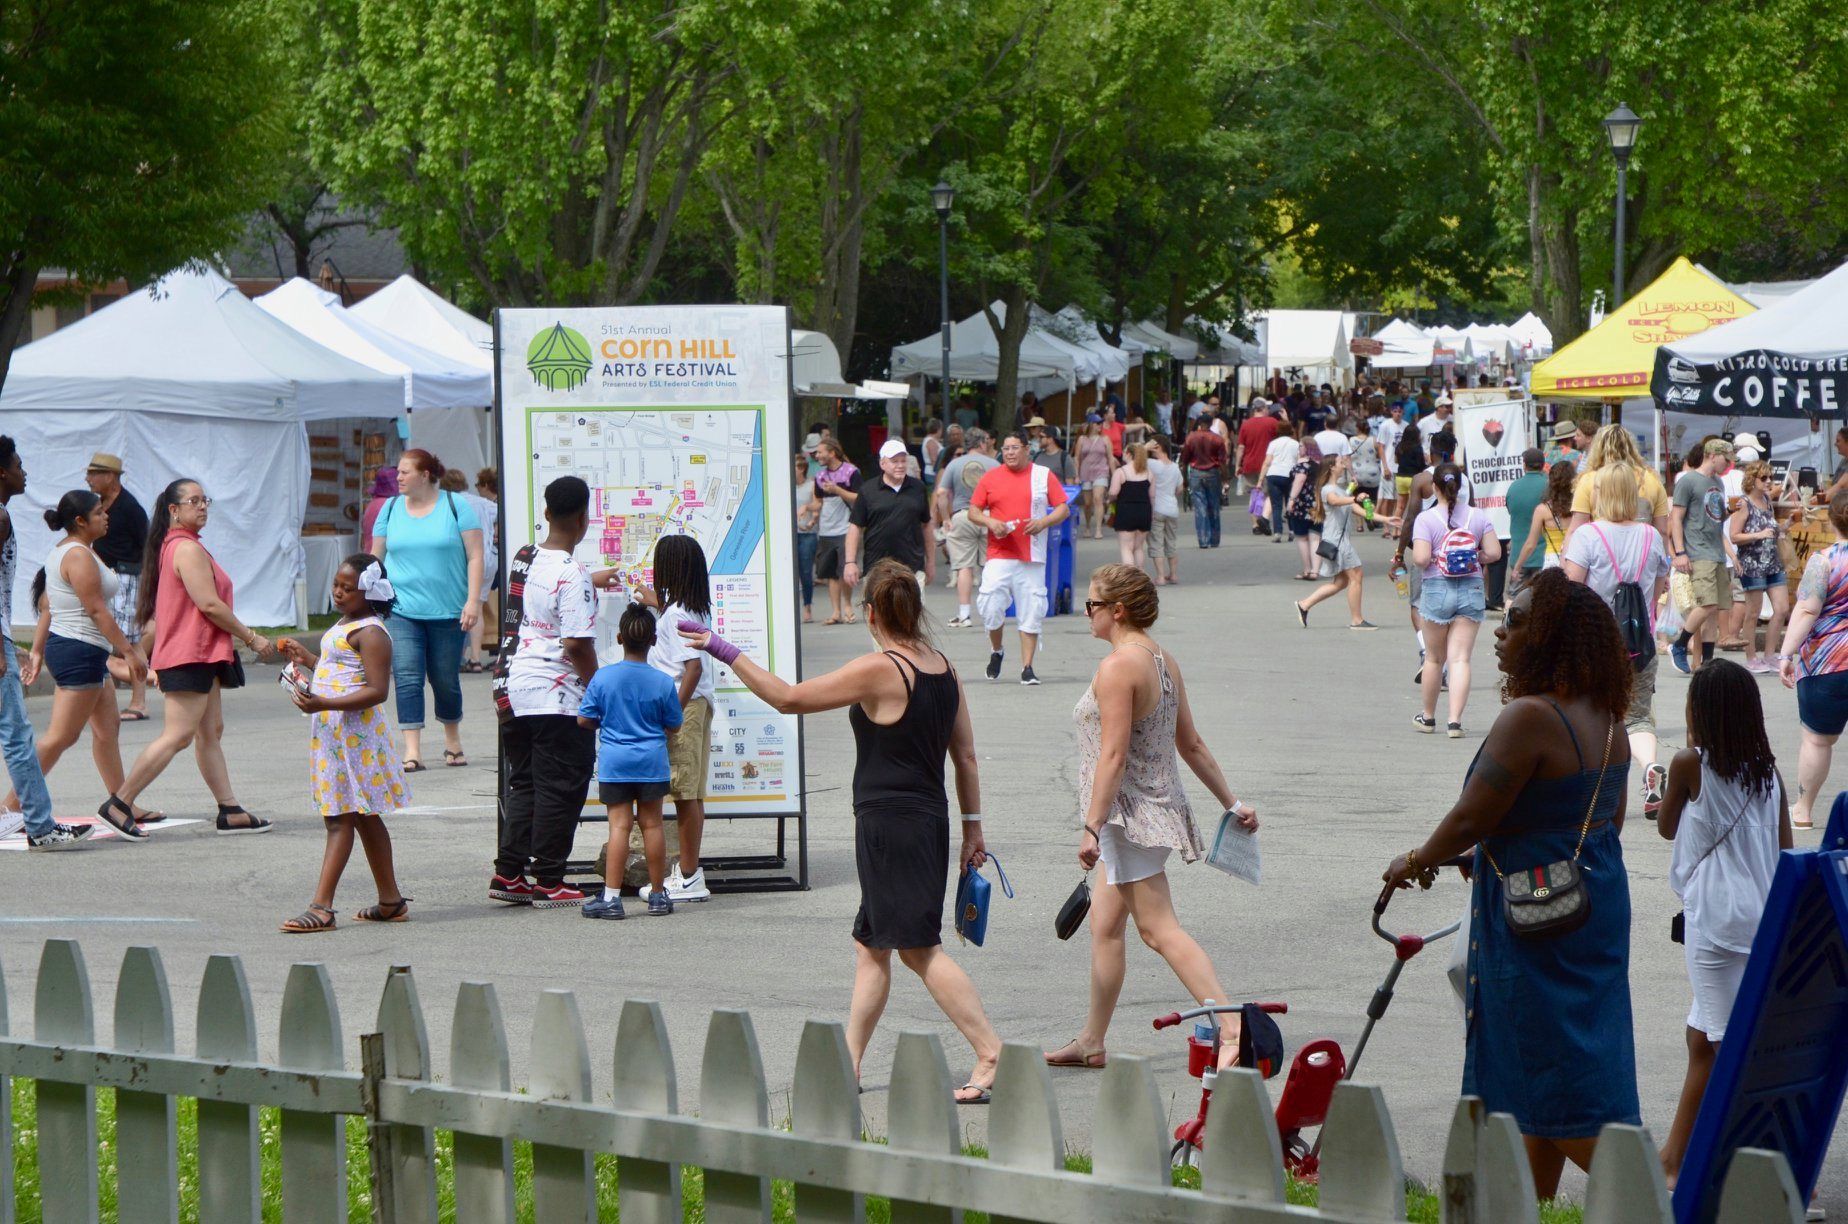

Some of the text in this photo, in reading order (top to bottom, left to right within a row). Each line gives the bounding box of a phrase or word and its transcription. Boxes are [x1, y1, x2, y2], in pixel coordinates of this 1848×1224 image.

[1639, 301, 1735, 316] LEMON
[601, 324, 672, 335] 51st Annual
[680, 339, 736, 359] HILL
[602, 363, 737, 377] ARTS FESTIVAL
[1713, 355, 1767, 372] NITRO
[1773, 356, 1809, 372] COLD
[639, 381, 647, 389] by
[664, 380, 691, 388] Federal
[692, 380, 714, 388] Credit
[715, 380, 737, 388] Union
[1563, 375, 1641, 389] ICE COLD
[1471, 455, 1523, 469] CHOCOLATE
[1473, 468, 1523, 484] COVERED
[729, 728, 747, 736] CITY
